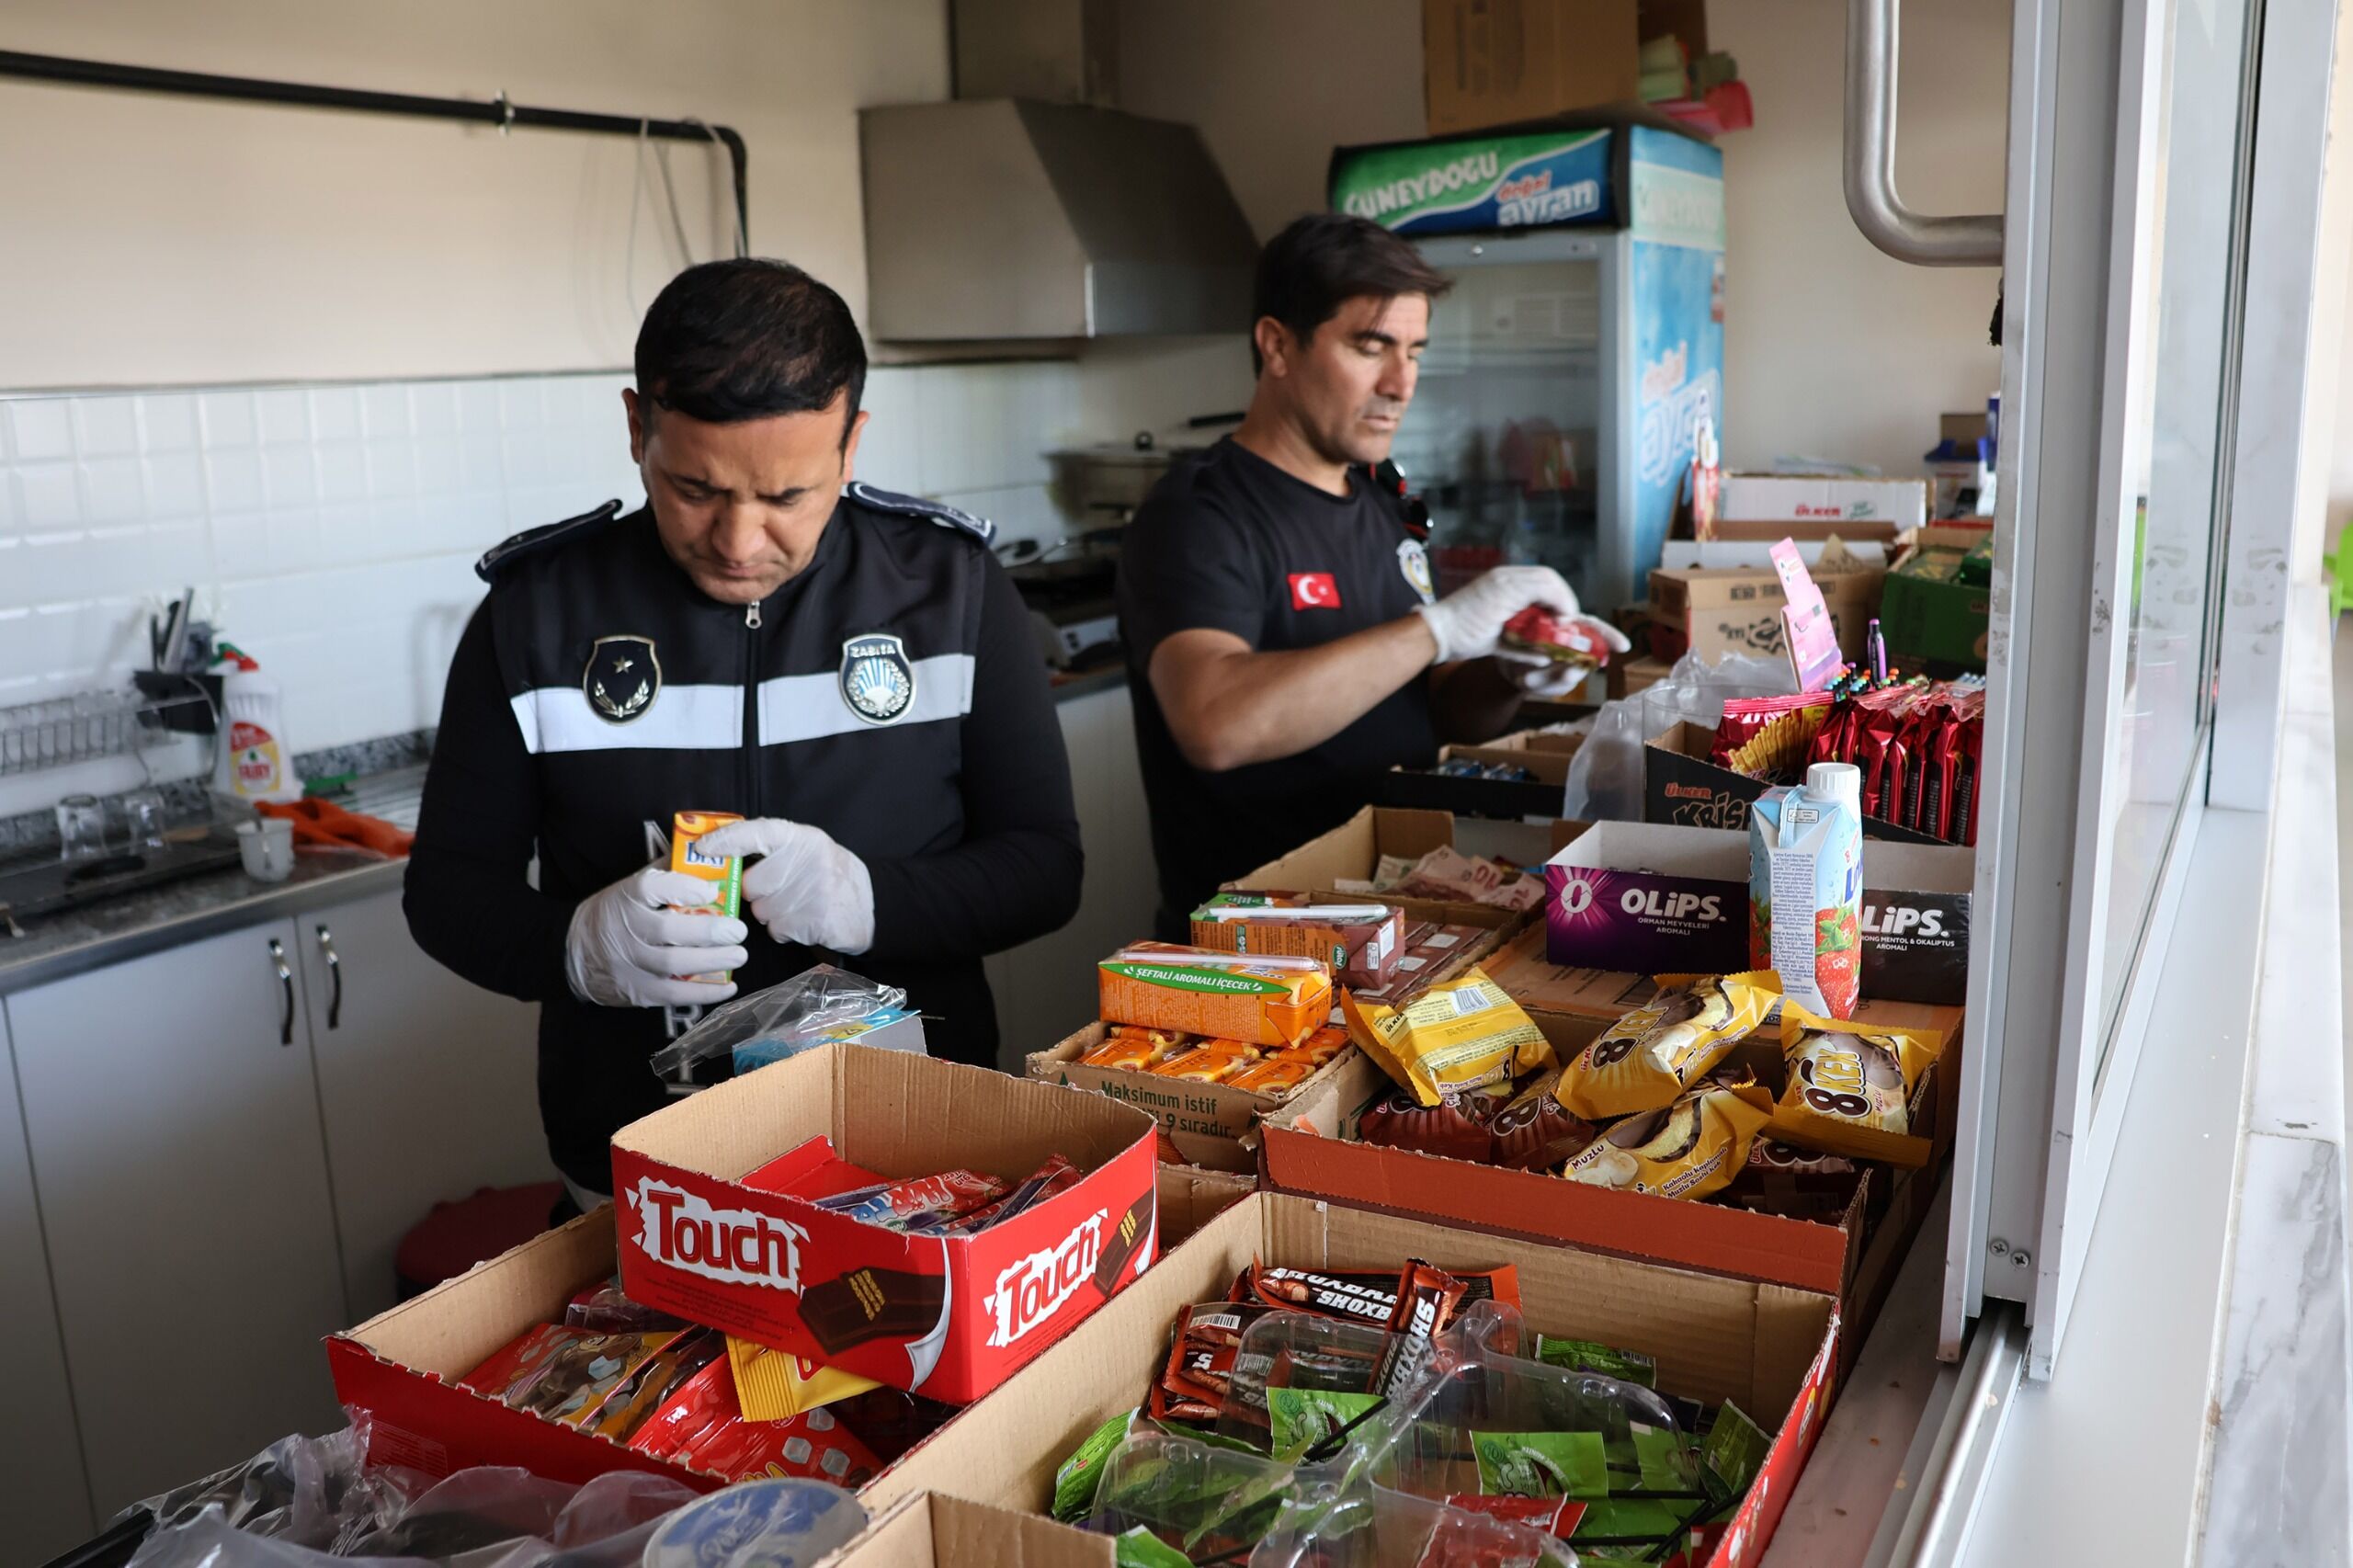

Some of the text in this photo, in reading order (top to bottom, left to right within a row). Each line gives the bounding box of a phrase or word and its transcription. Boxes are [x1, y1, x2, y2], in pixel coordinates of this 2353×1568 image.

[1665, 783, 1711, 800] ÜLKER
[1638, 917, 1710, 930] ORMAN MEYVELERİ
[1656, 927, 1690, 936] AROMALI
[1876, 943, 1908, 951] AROMALI
[1881, 937, 1908, 945] MENTOL
[1136, 968, 1251, 991] ŞEFTALİ AROMALI İÇECEK
[1102, 1080, 1180, 1108] Maksimum
[1185, 1097, 1217, 1116] istif
[1166, 1113, 1176, 1128] 9
[1663, 1171, 1693, 1191] Kakaolu
[1667, 1183, 1690, 1199] Muzlu
[647, 1189, 789, 1278] Touch
[1004, 1225, 1095, 1337] Touch
